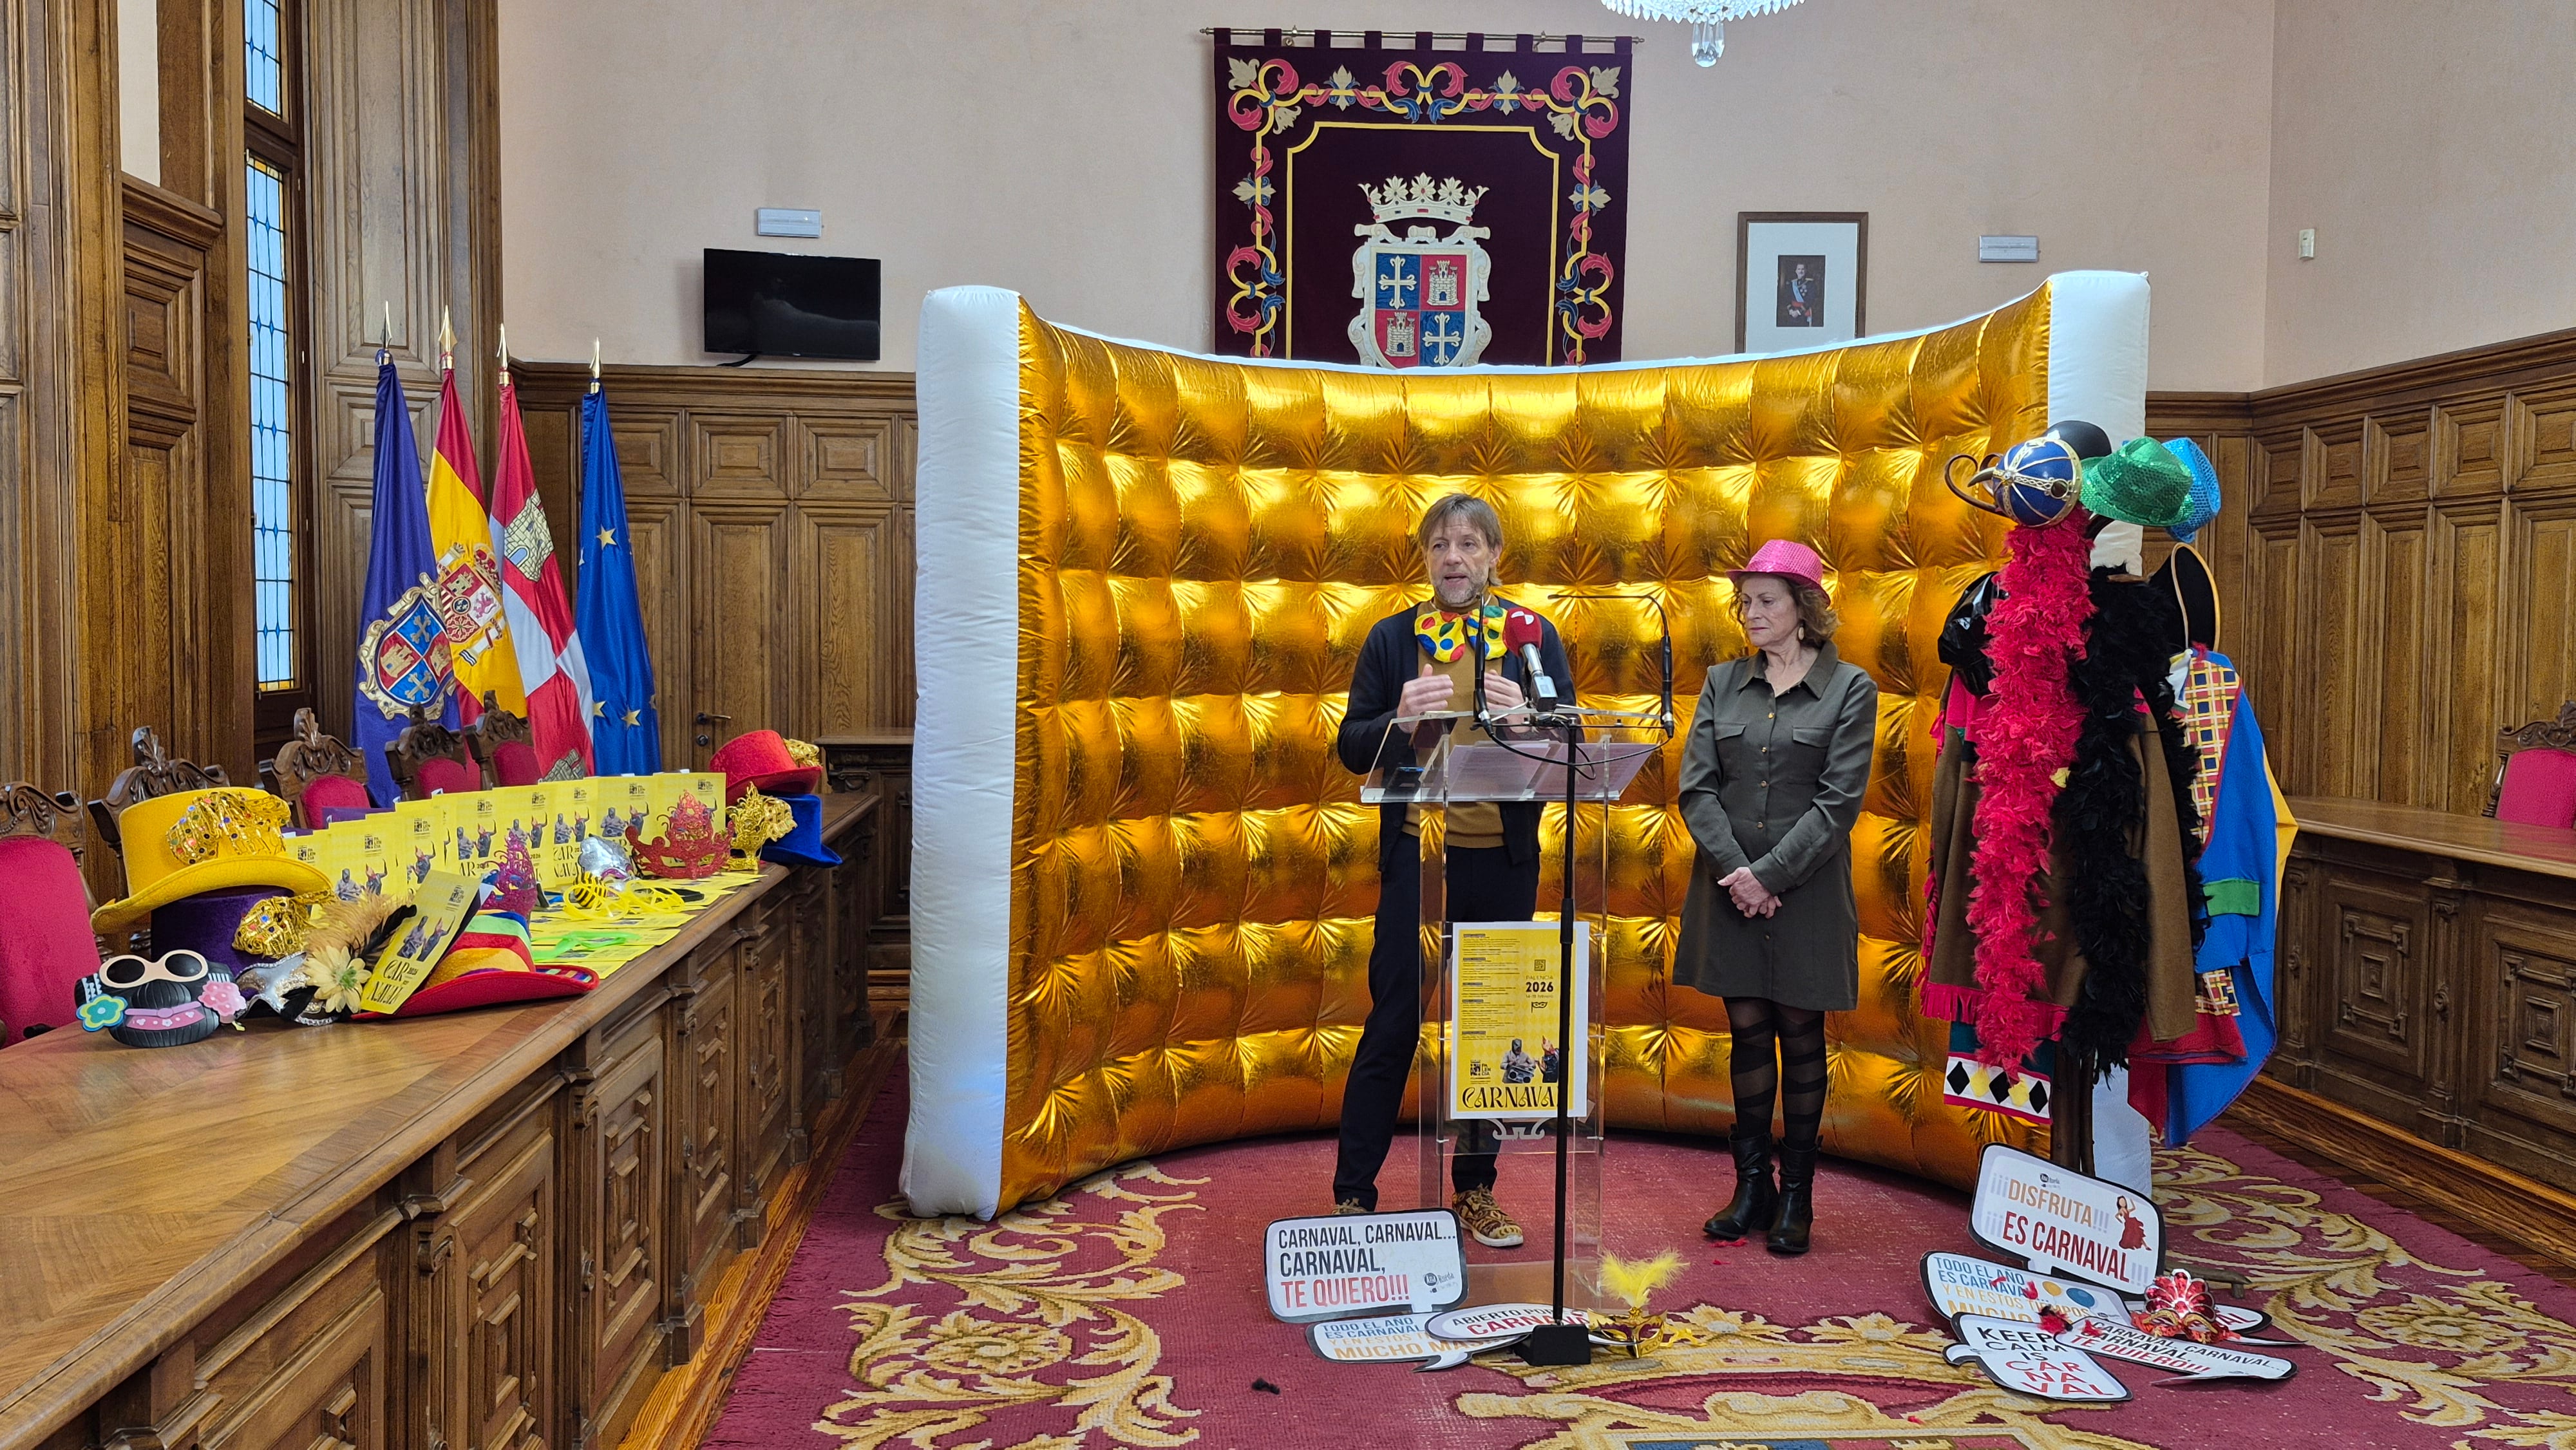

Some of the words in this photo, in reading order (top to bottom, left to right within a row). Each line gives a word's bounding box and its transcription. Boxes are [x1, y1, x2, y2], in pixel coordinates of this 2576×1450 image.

[459, 862, 476, 876] AR
[1526, 981, 1554, 992] 2026
[1462, 1086, 1558, 1109] CARNAVA
[1278, 1226, 1361, 1249] CARNAVAL,
[1365, 1221, 1456, 1244] CARNAVAL...
[1280, 1248, 1386, 1277] CARNAVAL,
[1933, 1256, 1972, 1274] TODO
[1975, 1265, 1994, 1278] EL
[1996, 1268, 2025, 1286] AÑO
[1281, 1280, 1308, 1308] TE
[1312, 1274, 1410, 1307] QUIERO!!!
[1938, 1270, 1956, 1284] ES
[1960, 1274, 2049, 1303] CARNAVA...
[1942, 1283, 1951, 1295] Y
[1955, 1285, 1976, 1300] EN
[1978, 1287, 2024, 1310] ESTOS
[1323, 1323, 1359, 1332] TODO
[1363, 1321, 1381, 1330] EL
[1385, 1317, 1414, 1326] AÑO
[1452, 1310, 1522, 1326] ABIERTO
[1466, 1315, 1590, 1335] CARNAVA
[1325, 1331, 1344, 1339] ES
[1367, 1333, 1412, 1344] ESTOS
[1976, 1326, 2054, 1343] KEEP
[1334, 1343, 1423, 1359] MUCHO
[1985, 1341, 2068, 1352] CALM
[2070, 1335, 2101, 1348] TE
[2101, 1343, 2211, 1373] QUIERO!!!
[2020, 1352, 2049, 1361] IS
[2005, 1361, 2086, 1373] CAR
[2024, 1371, 2087, 1384] NA
[2020, 1382, 2114, 1396] VAL
